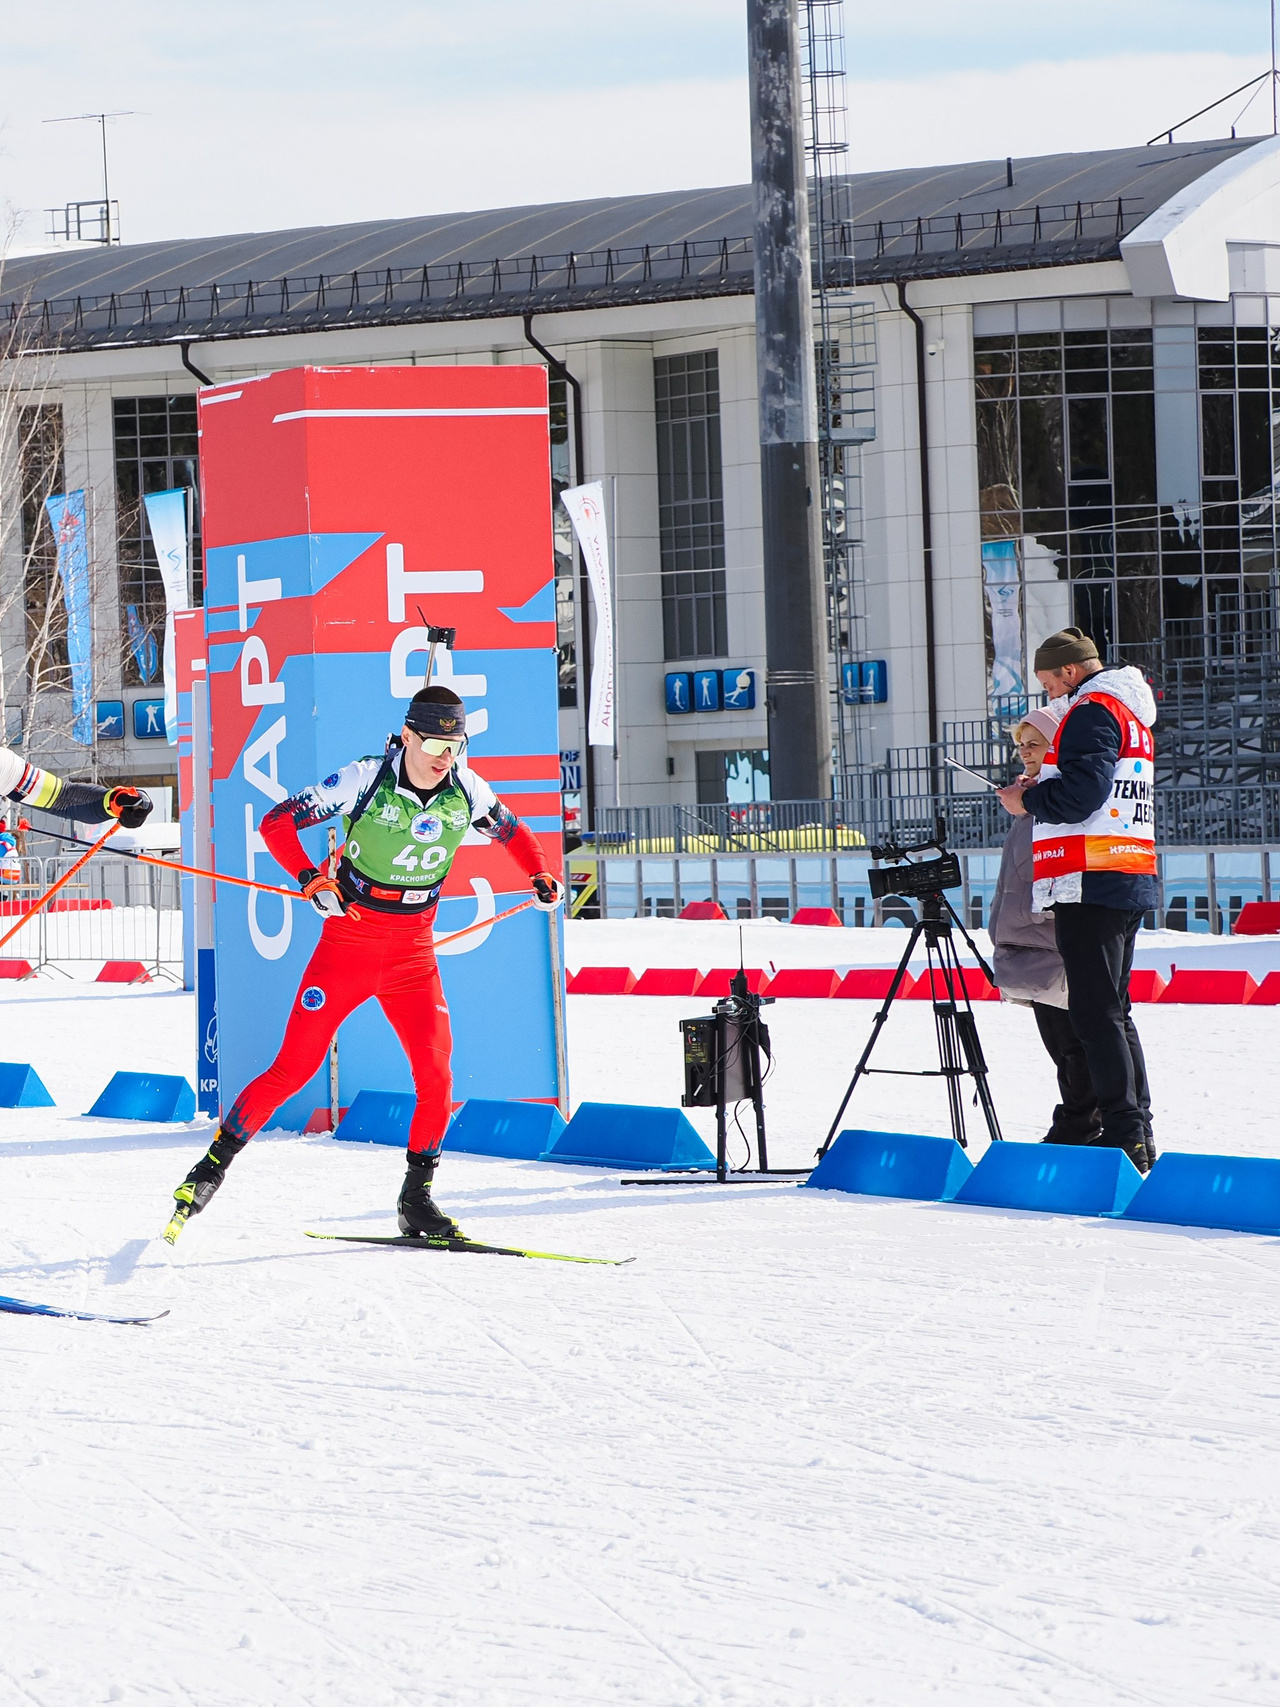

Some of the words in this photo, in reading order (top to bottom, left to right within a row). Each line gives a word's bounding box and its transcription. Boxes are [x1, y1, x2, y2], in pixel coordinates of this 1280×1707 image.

[236, 554, 292, 961] СТАРТ
[391, 844, 448, 872] 40
[389, 873, 436, 883] КРАСНОЯРСК
